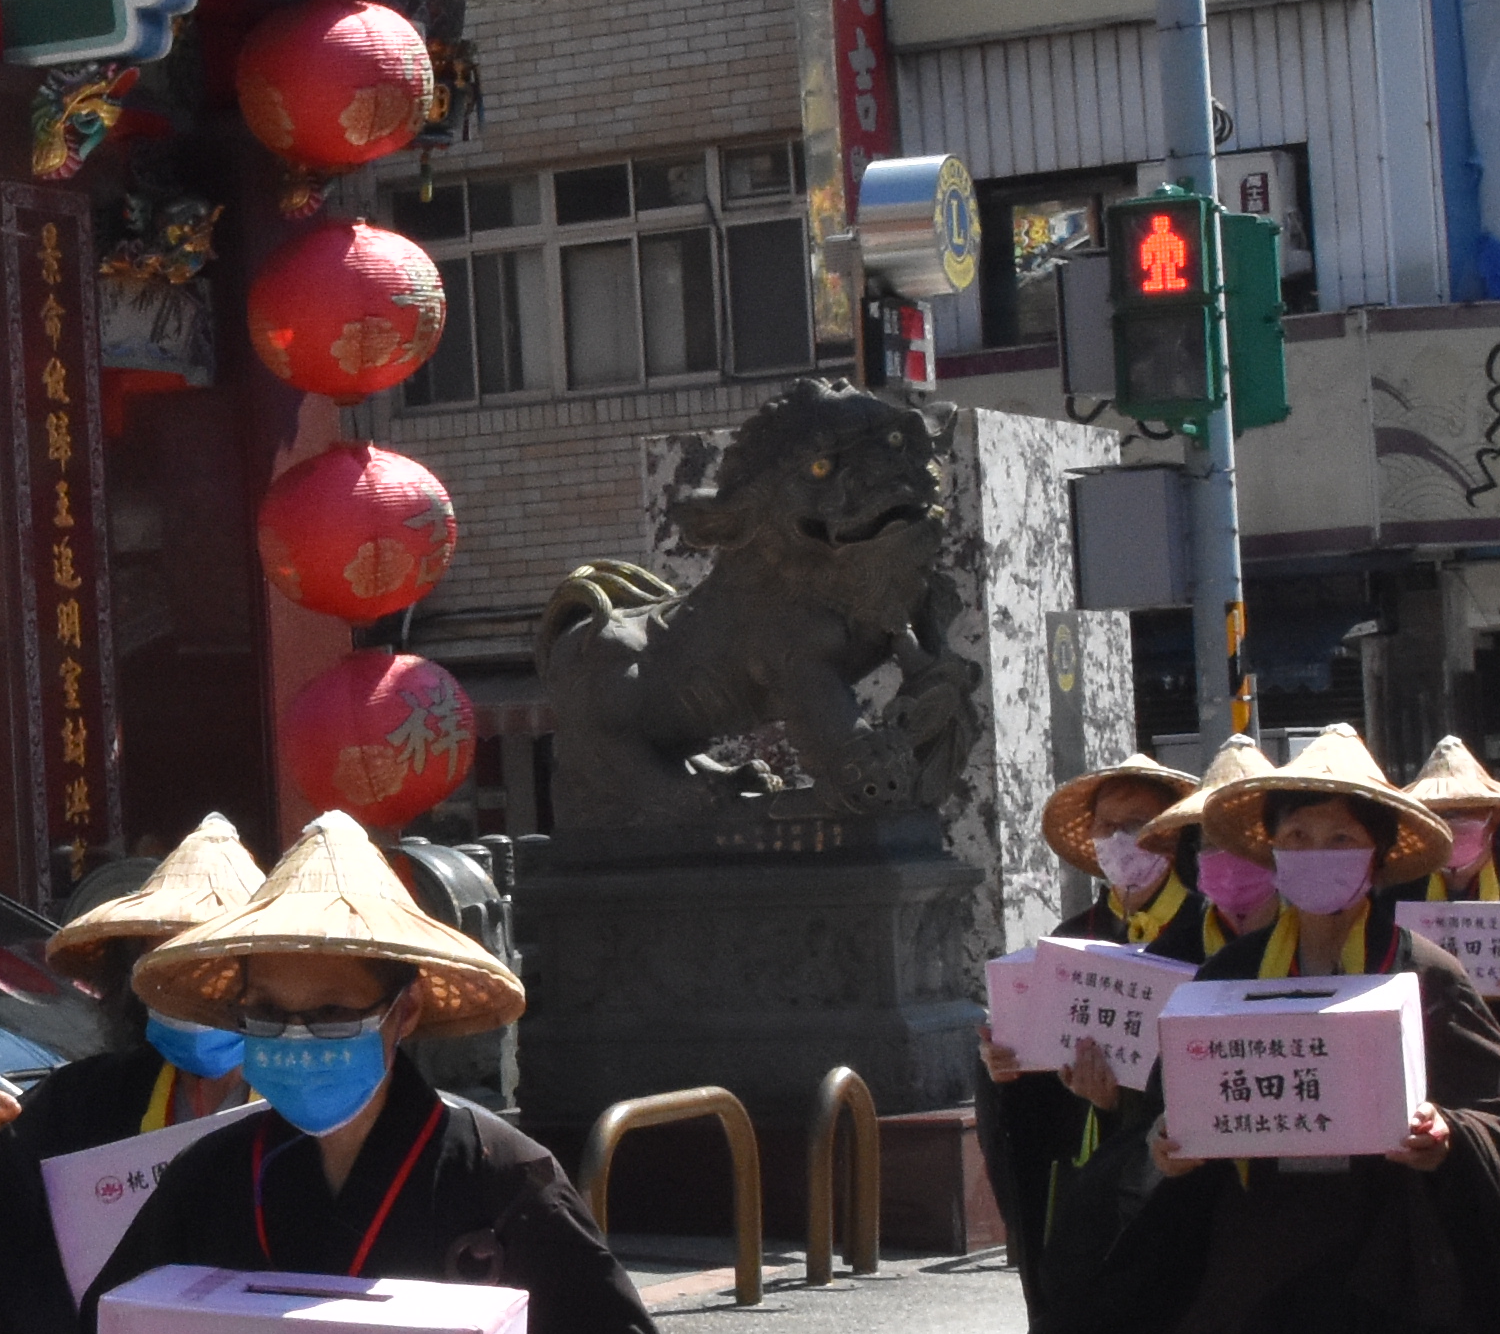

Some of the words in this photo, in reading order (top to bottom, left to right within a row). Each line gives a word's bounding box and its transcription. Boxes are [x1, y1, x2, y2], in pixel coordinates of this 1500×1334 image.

[388, 681, 470, 785] 祥
[1069, 998, 1143, 1038] 福田箱
[1209, 1038, 1328, 1060] 桃園佛教蓮社
[1219, 1068, 1321, 1103] 福田箱
[1213, 1113, 1332, 1134] 短期出家戒會
